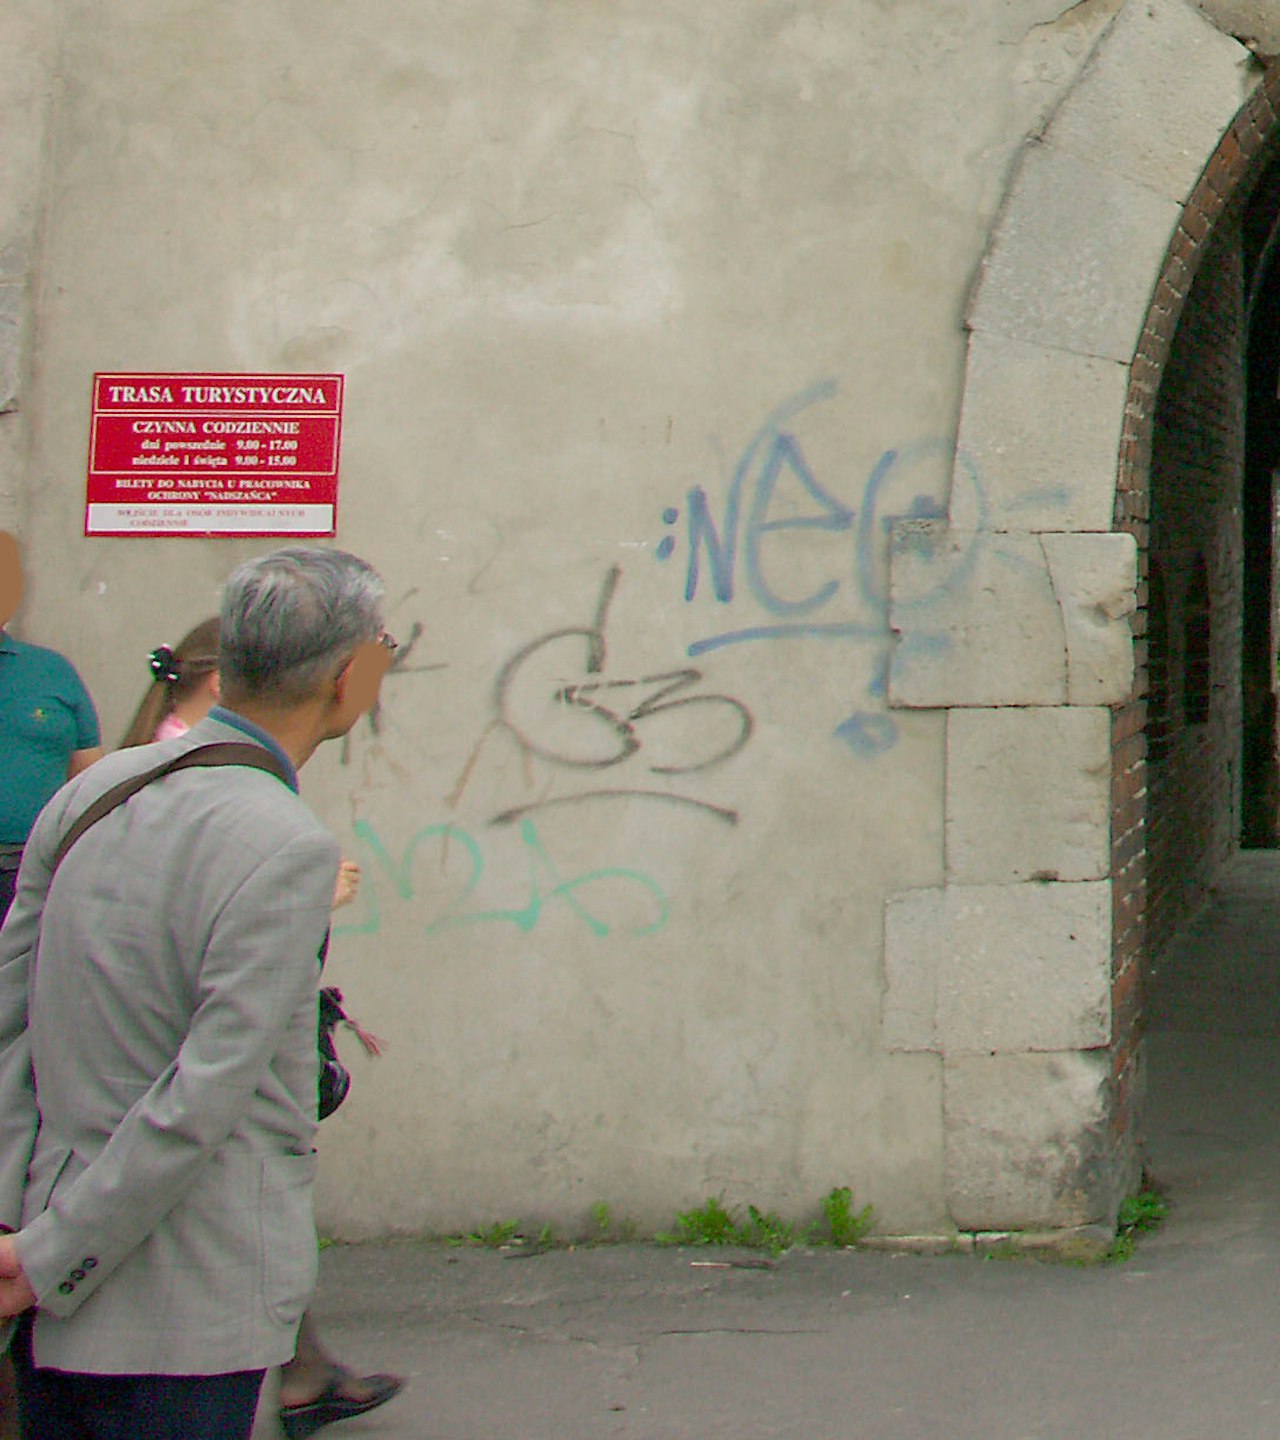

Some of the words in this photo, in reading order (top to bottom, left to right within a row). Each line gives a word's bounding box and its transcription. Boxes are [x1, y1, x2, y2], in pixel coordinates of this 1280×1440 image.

[109, 386, 173, 403] TRASA
[181, 387, 326, 404] TURYSTYCZNA
[132, 421, 196, 433] CZYNNA
[202, 421, 300, 434] CODZIENNIE
[141, 439, 160, 449] dni
[165, 439, 226, 452] powszednie
[236, 440, 260, 450] 9.00
[269, 440, 298, 450] 17.00
[132, 454, 180, 465] niedziele
[235, 455, 259, 465] 9.00
[268, 455, 297, 465] 15.00
[115, 479, 154, 488] BILETY
[157, 479, 175, 488] DO
[178, 479, 224, 488] NABYCIA
[227, 479, 236, 488] U
[239, 480, 311, 489] PRACOWNIKA
[147, 491, 200, 500] OCHRONY
